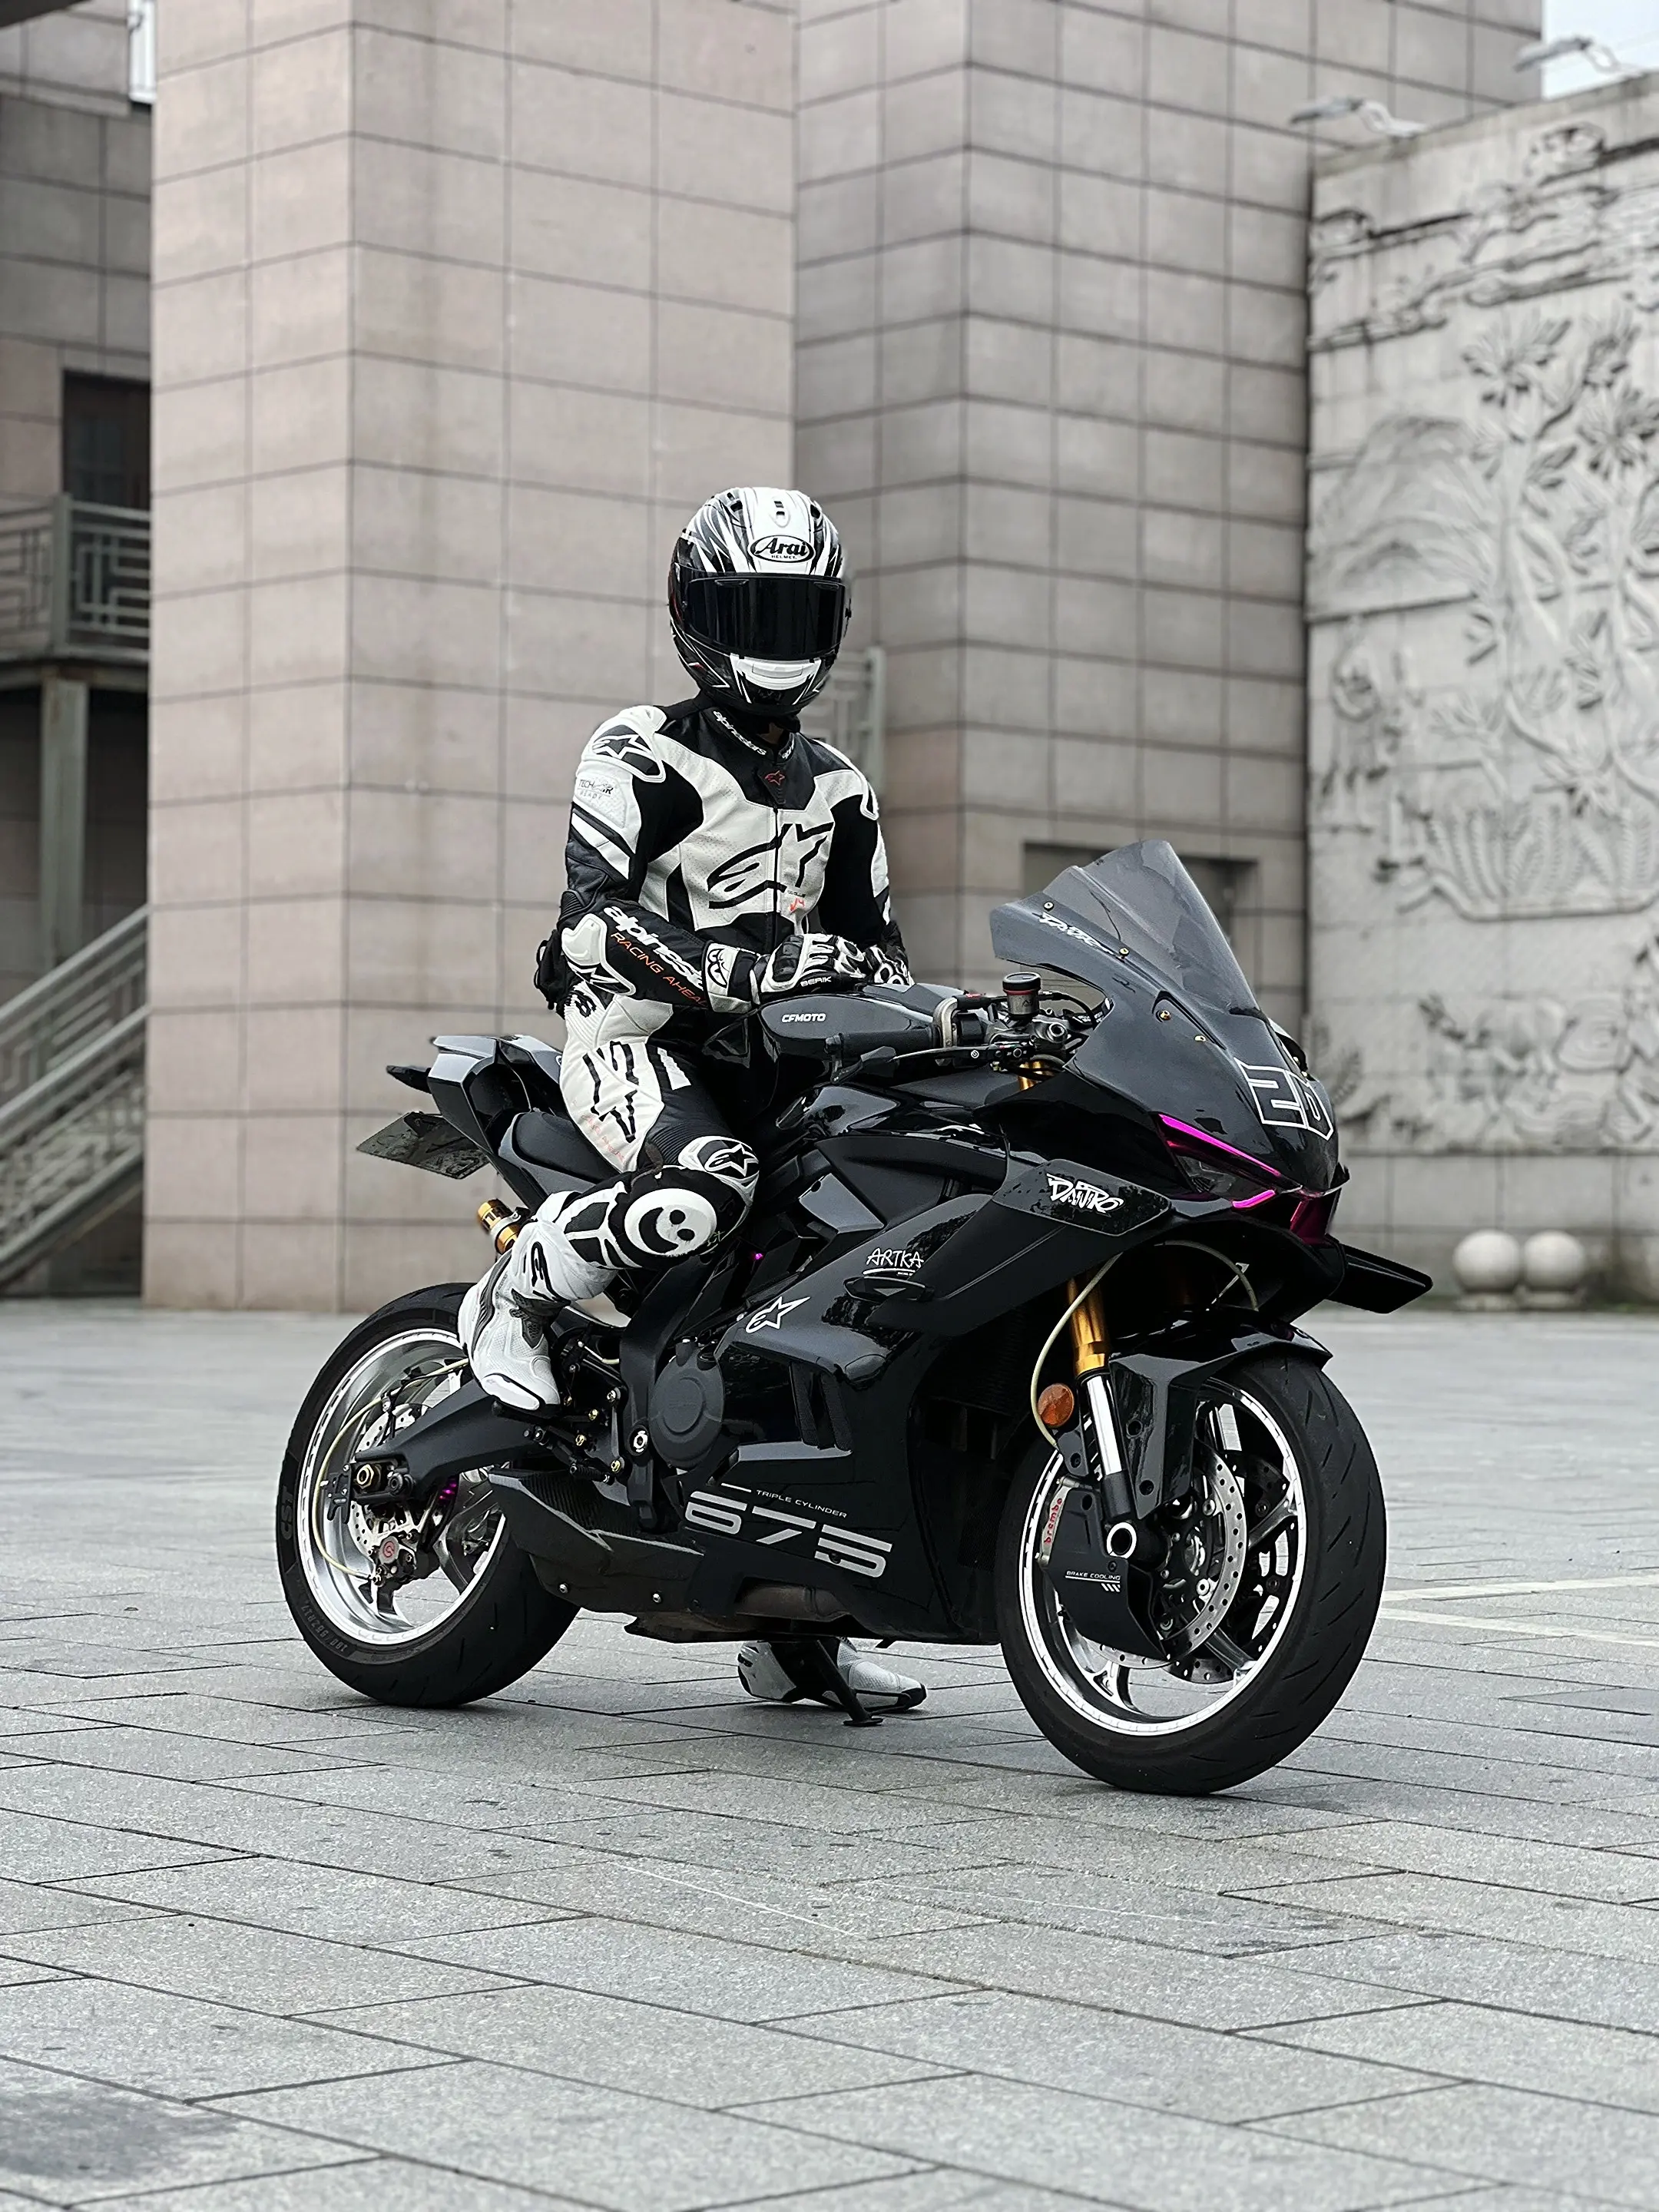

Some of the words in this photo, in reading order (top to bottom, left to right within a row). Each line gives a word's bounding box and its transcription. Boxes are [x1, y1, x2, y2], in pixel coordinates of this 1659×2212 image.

[755, 538, 807, 556] Arai
[611, 932, 664, 974] RACING
[800, 975, 832, 987] BERIK
[781, 1012, 826, 1023] CFMOTO
[866, 1247, 924, 1269] ARTKA
[756, 1489, 792, 1503] TRIPLE
[795, 1499, 847, 1518] CYLINDER
[1044, 1498, 1063, 1543] brembo
[684, 1490, 892, 1578] 675
